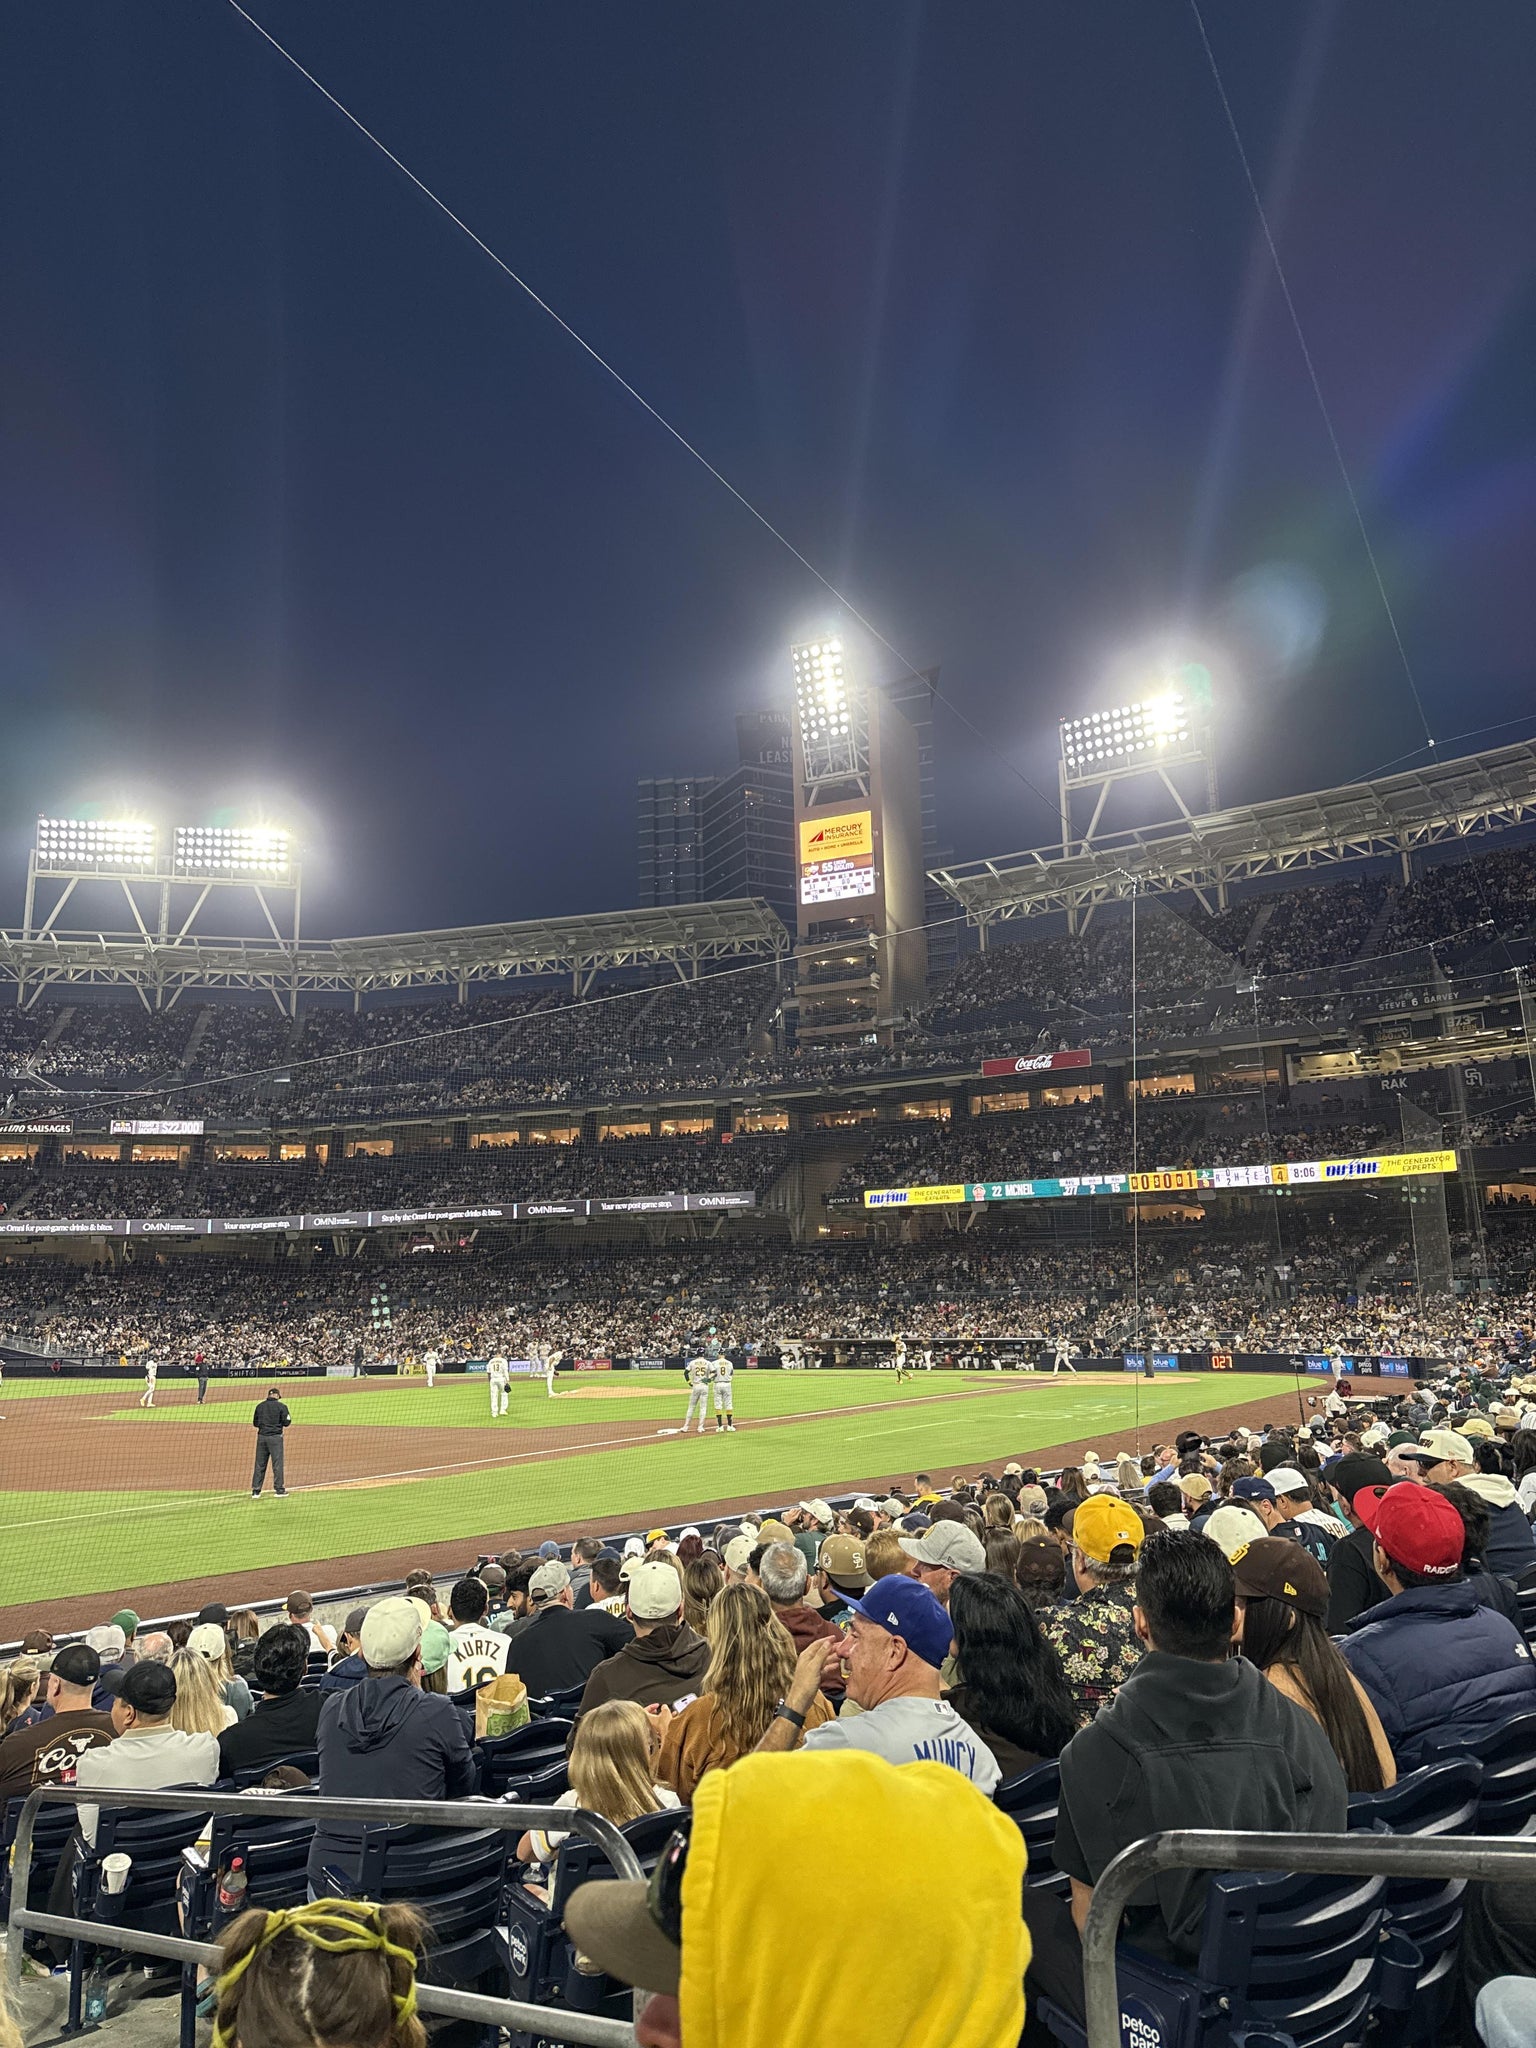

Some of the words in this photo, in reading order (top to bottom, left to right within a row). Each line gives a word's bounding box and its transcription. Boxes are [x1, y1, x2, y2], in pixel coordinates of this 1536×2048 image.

[825, 823, 863, 834] MERCURY
[825, 829, 863, 840] INSURANCE
[1378, 1000, 1406, 1011] STEVE
[1411, 997, 1419, 1006] 6
[1423, 991, 1459, 1004] GARVEY
[1014, 1054, 1054, 1072] Coca-Cola
[1381, 1077, 1408, 1090] RAK
[27, 1124, 71, 1134] SAUSAGES
[1403, 1154, 1451, 1165] GENERATOR
[1293, 1167, 1315, 1178] 8:06
[1402, 1163, 1436, 1172] EXPERTS
[1141, 1174, 1149, 1190] 0
[1163, 1173, 1172, 1188] 0
[1187, 1171, 1194, 1187] 1
[1277, 1170, 1284, 1182] 4
[991, 1186, 1003, 1197] 22
[1111, 1183, 1121, 1193] 15
[699, 1196, 726, 1206] OMNI
[527, 1206, 553, 1215] OMNI
[142, 1222, 170, 1231] OMNI
[313, 1217, 337, 1226] OMNI
[1211, 1354, 1232, 1369] 027
[1307, 1360, 1322, 1368] blue
[1358, 1361, 1372, 1369] petco
[1379, 1361, 1390, 1370] blue
[1395, 1362, 1406, 1371] blue
[493, 1363, 500, 1372] 13
[695, 1366, 706, 1377] 25
[720, 1366, 726, 1376] 8
[1361, 1366, 1373, 1374] park
[453, 1639, 501, 1662] KURTZ
[912, 1738, 976, 1781] MUNCY
[510, 1934, 527, 1954] petco
[1121, 2012, 1161, 2044] petco
